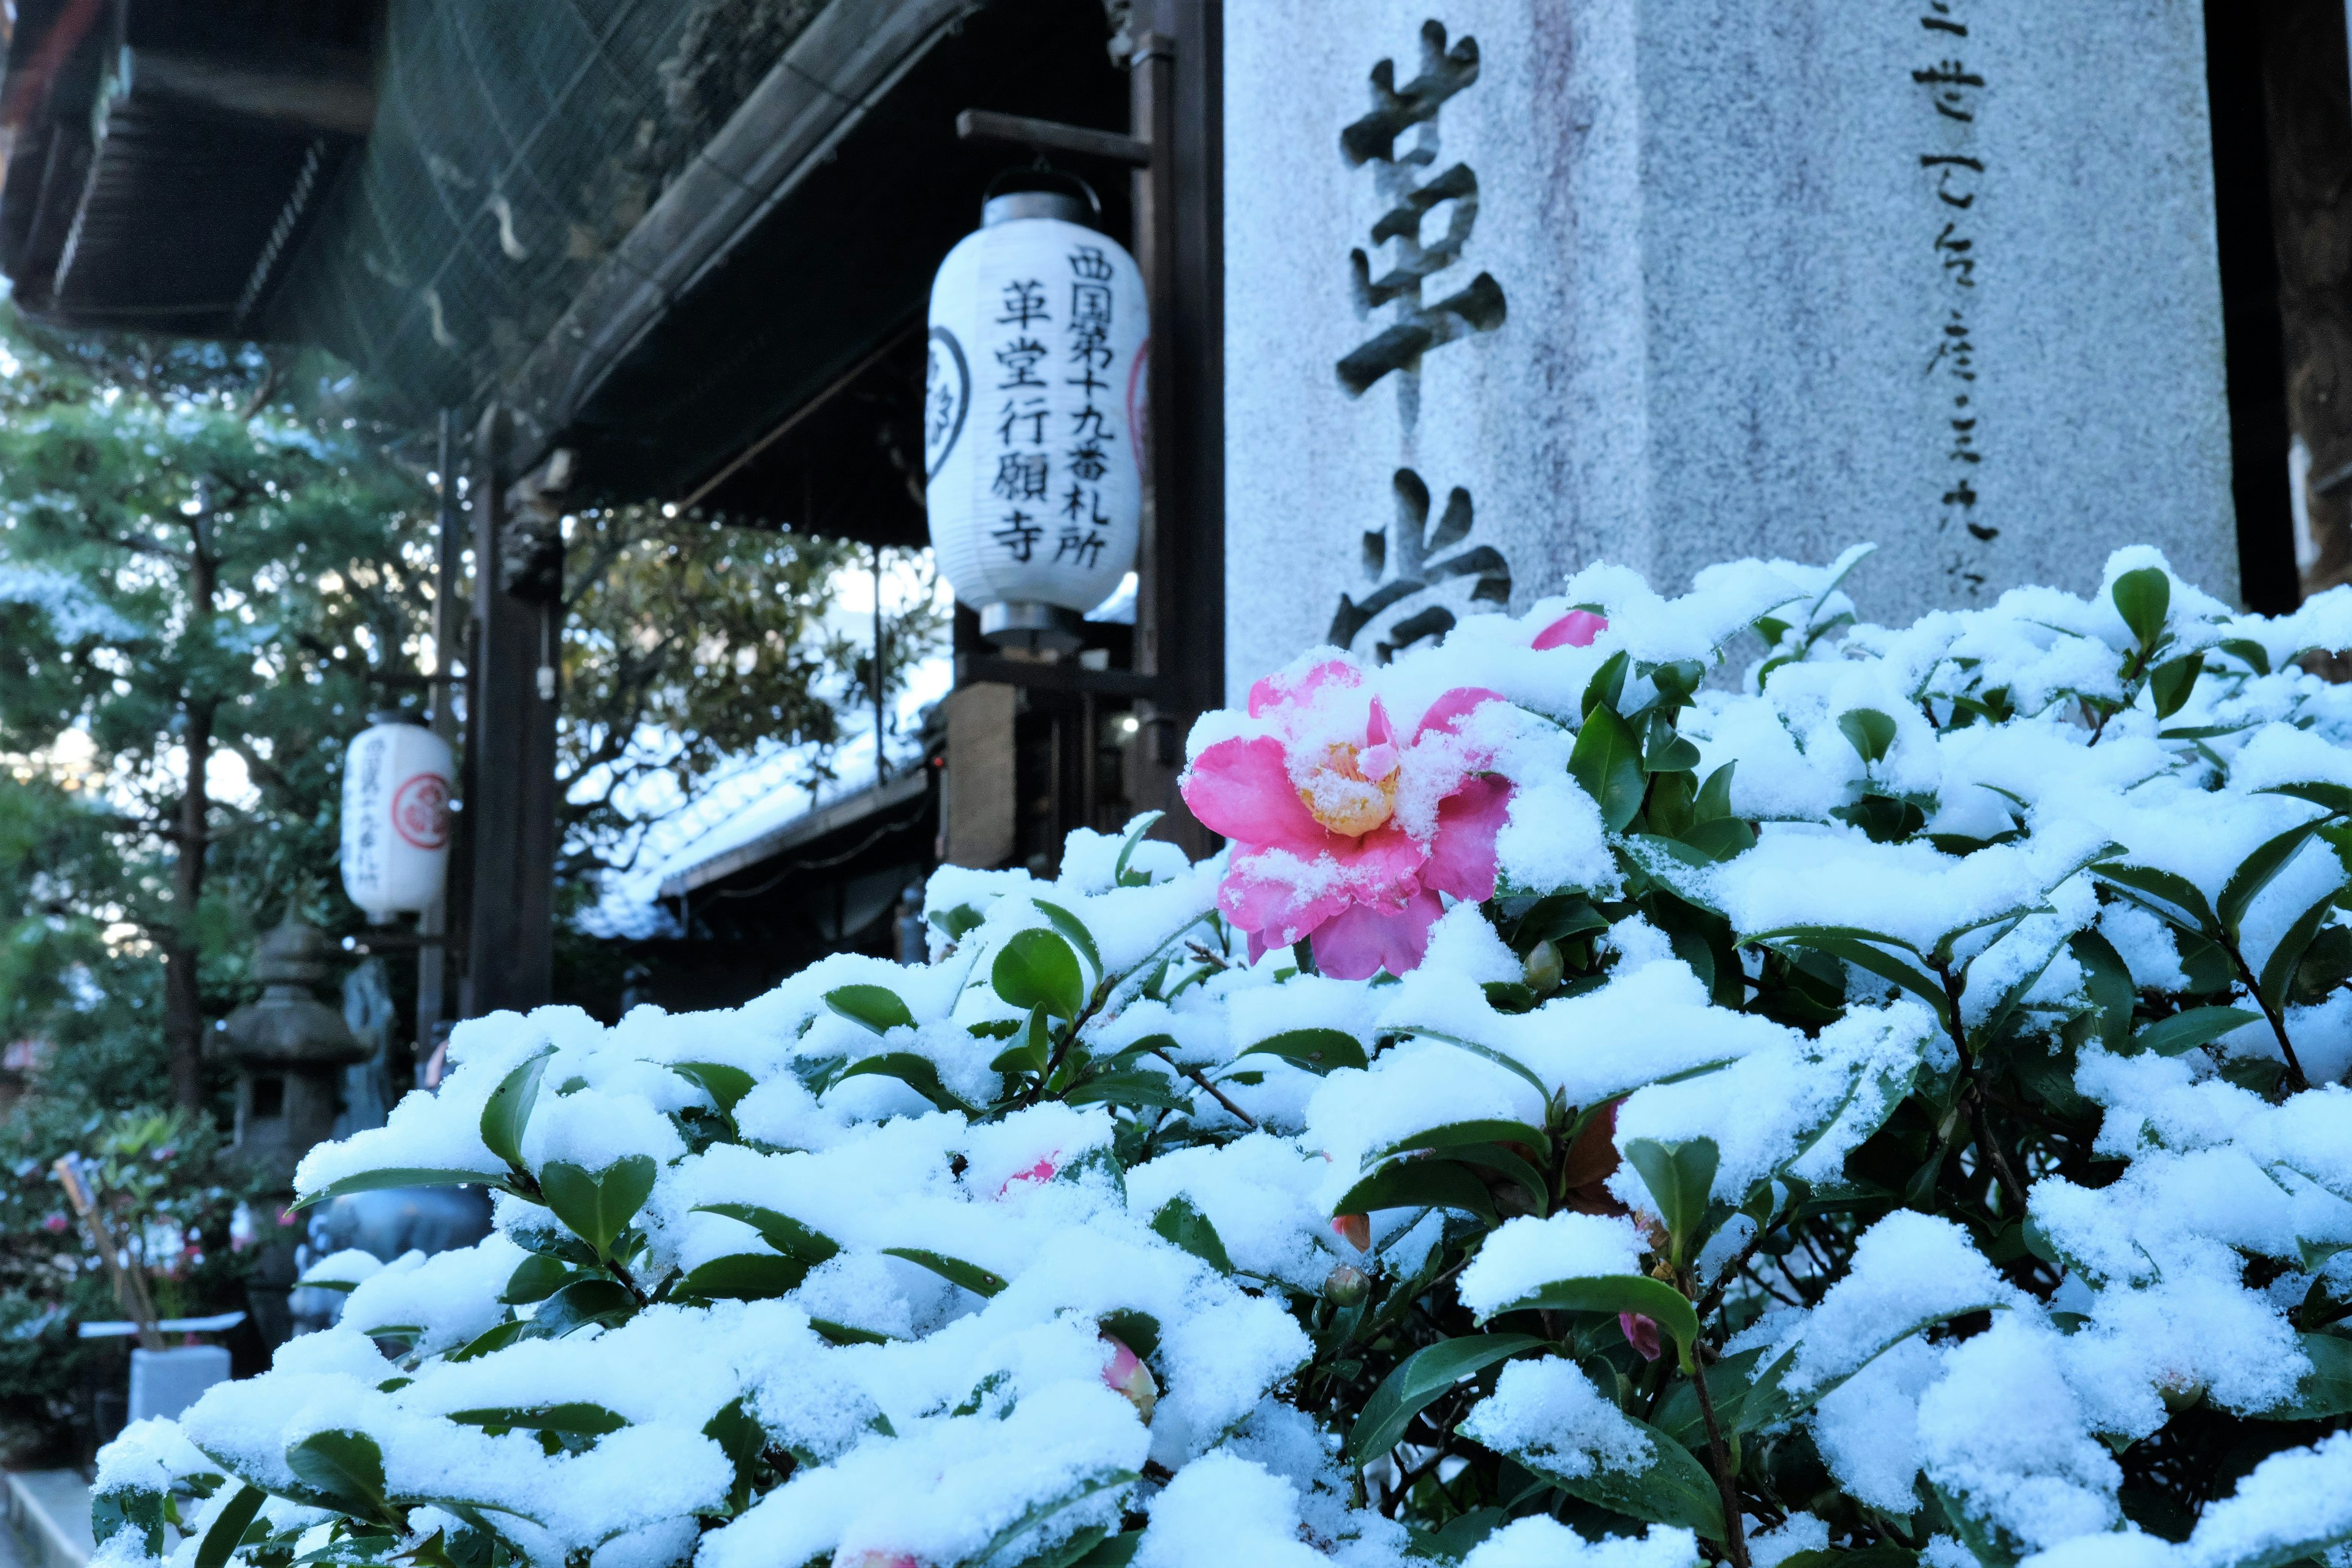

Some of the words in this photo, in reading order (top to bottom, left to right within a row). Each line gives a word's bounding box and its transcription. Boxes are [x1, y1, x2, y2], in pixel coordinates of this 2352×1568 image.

[992, 279, 1052, 564] 革堂行願寺
[1054, 244, 1115, 570] 西国第十九番札所
